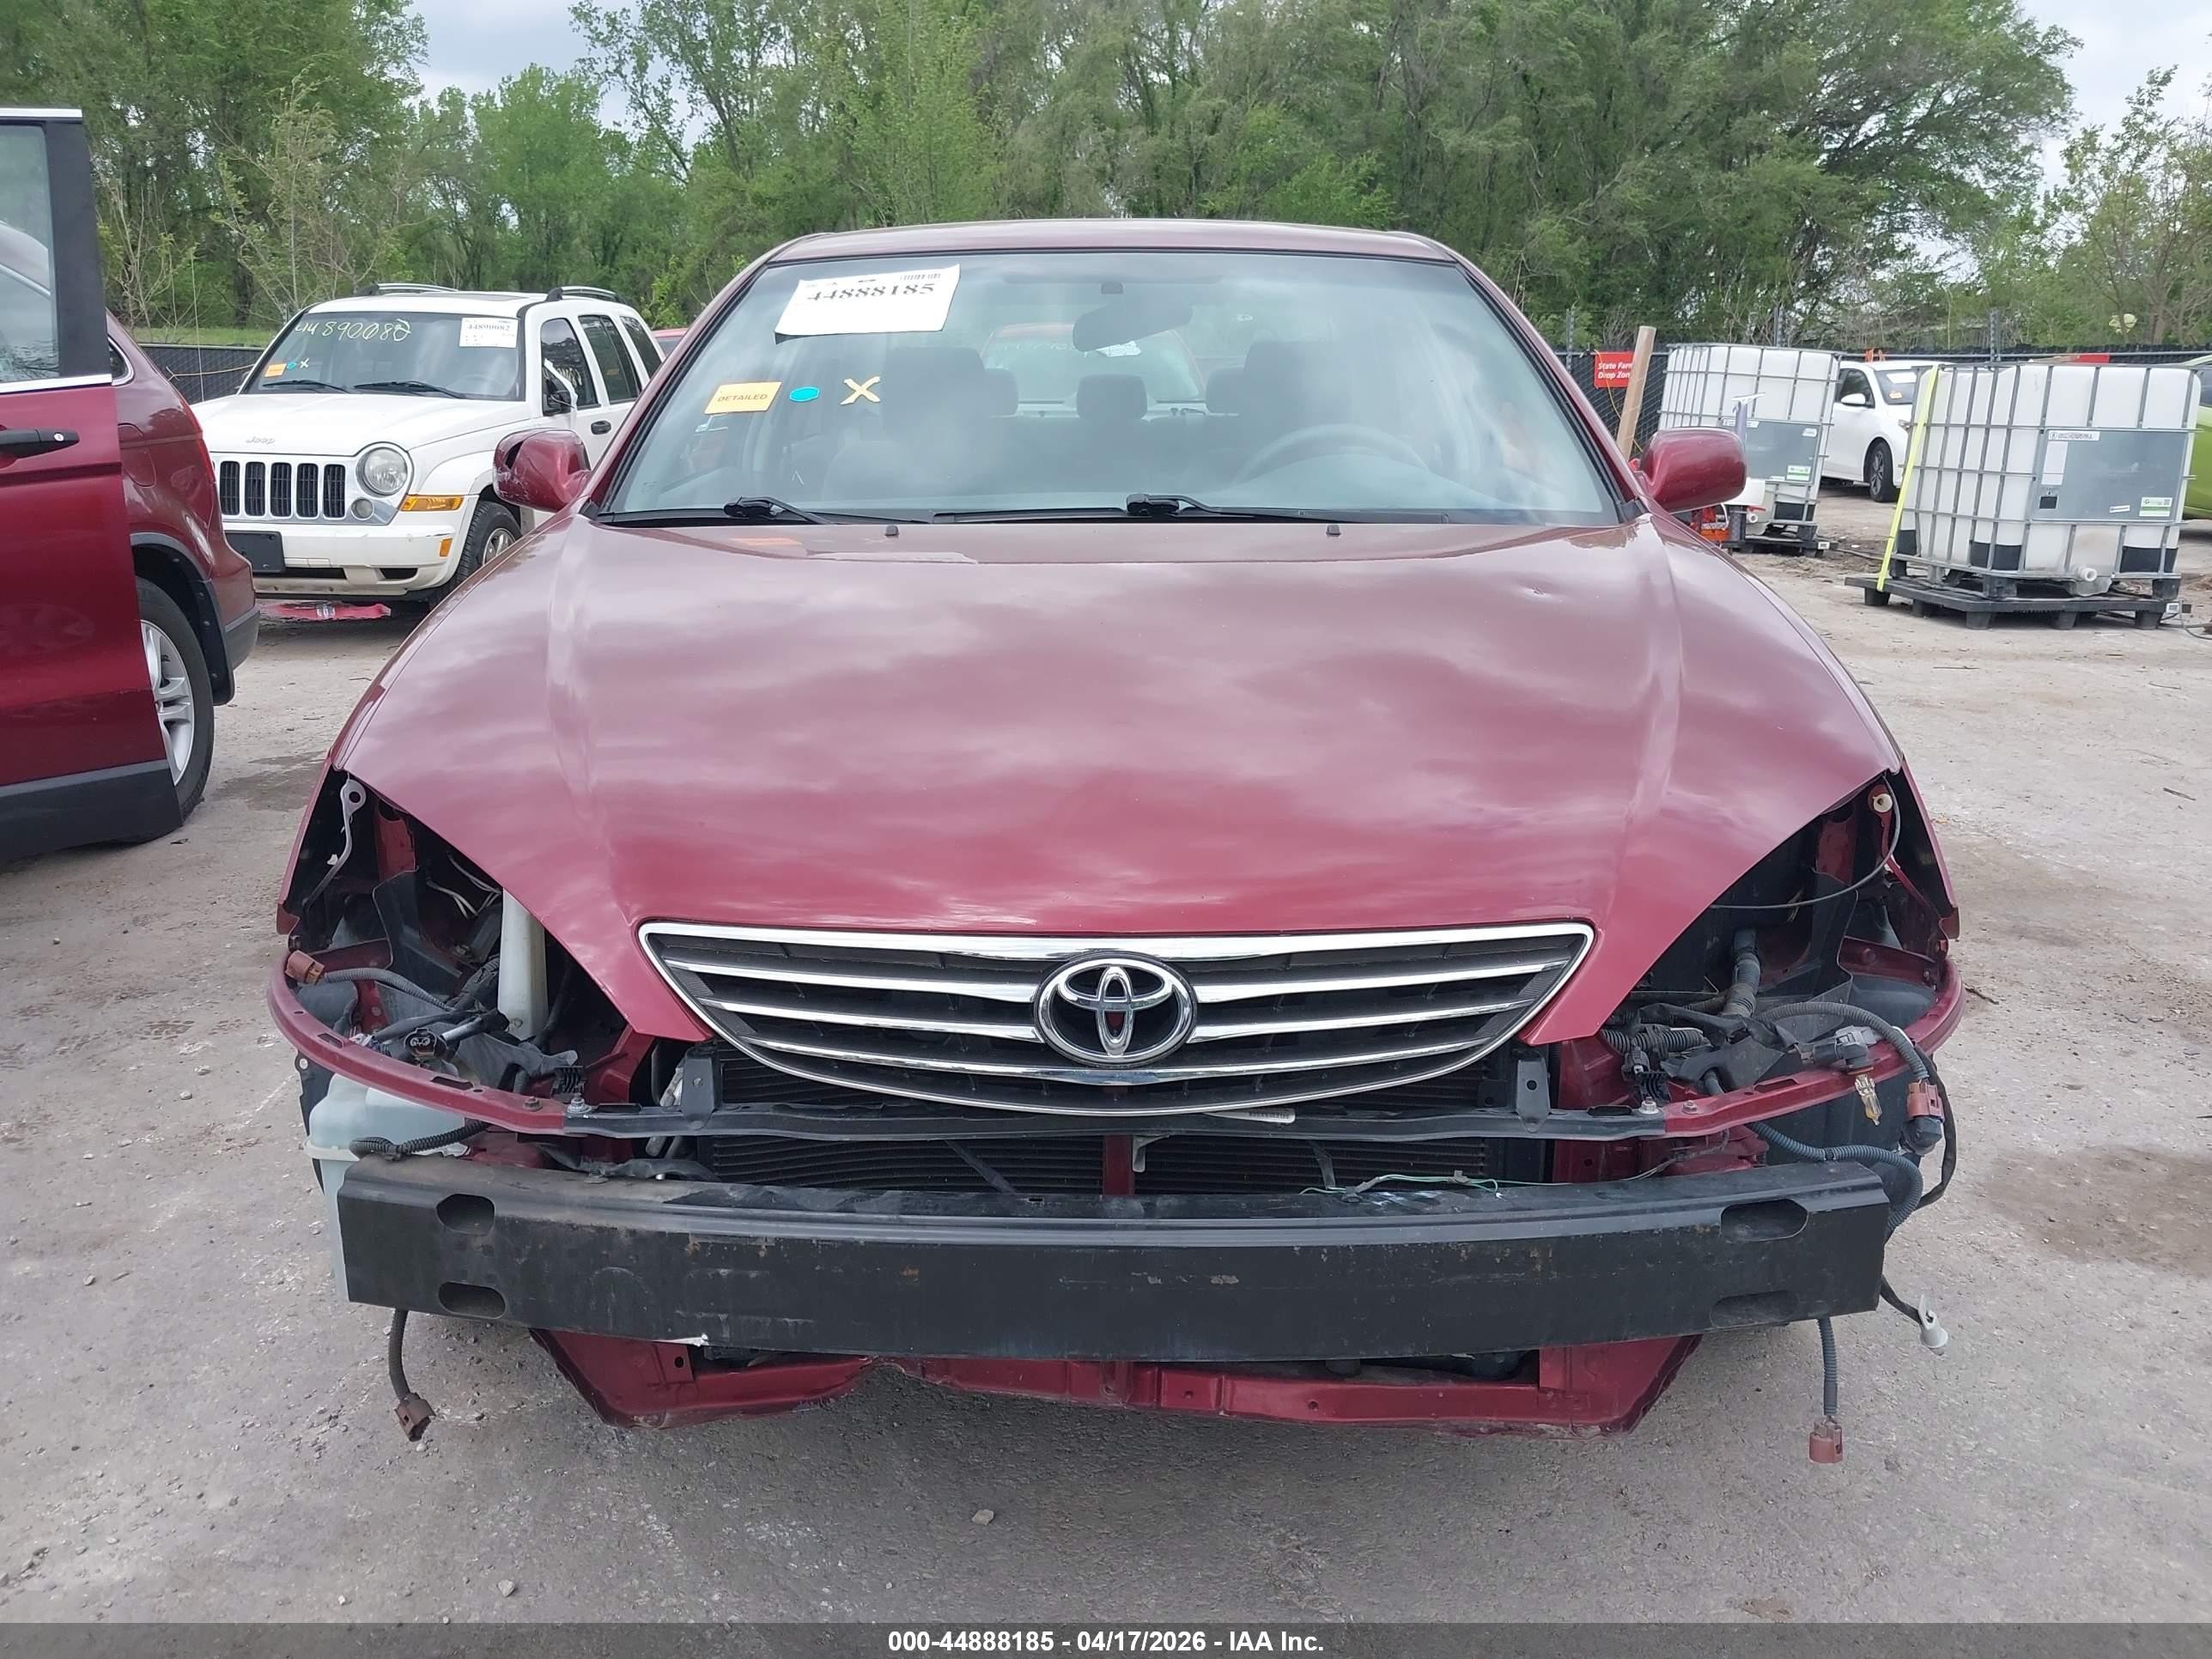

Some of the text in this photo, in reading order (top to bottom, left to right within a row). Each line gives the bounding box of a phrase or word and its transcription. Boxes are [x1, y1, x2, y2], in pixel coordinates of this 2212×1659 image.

[806, 283, 936, 301] 44888185
[1598, 371, 1615, 380] Drop
[717, 393, 769, 402] DETAILED
[245, 434, 276, 446] Jeep
